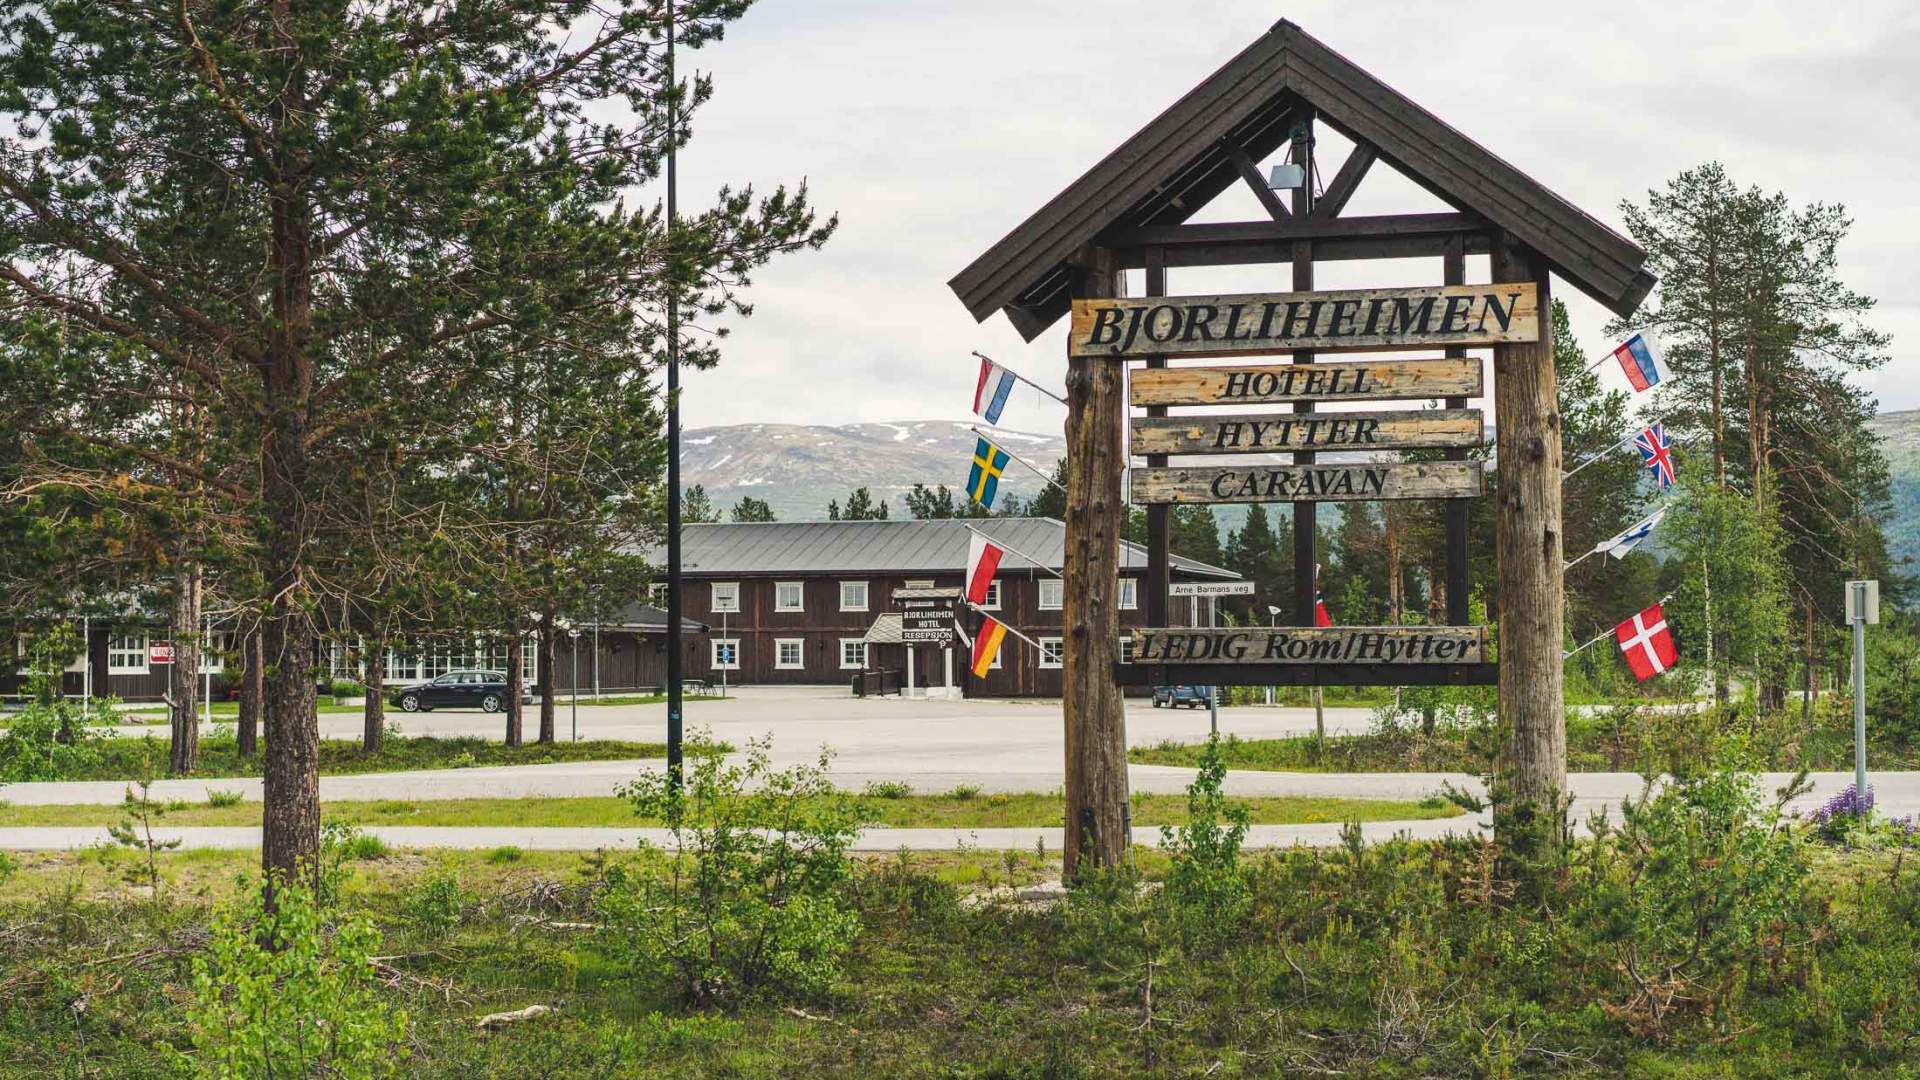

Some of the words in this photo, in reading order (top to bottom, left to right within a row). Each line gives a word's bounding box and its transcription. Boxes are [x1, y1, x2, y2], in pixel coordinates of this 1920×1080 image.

[1085, 293, 1522, 353] BJORLIHEIMEN
[1218, 368, 1374, 399] HOTELL
[1212, 418, 1380, 448] HYTTER
[1210, 469, 1390, 500] CARAVAN
[1175, 586, 1193, 594] Arne
[1197, 585, 1231, 593] Barmans
[1234, 585, 1249, 593] veg
[904, 631, 952, 639] RESEPSJON
[1136, 633, 1249, 661] LEDIG
